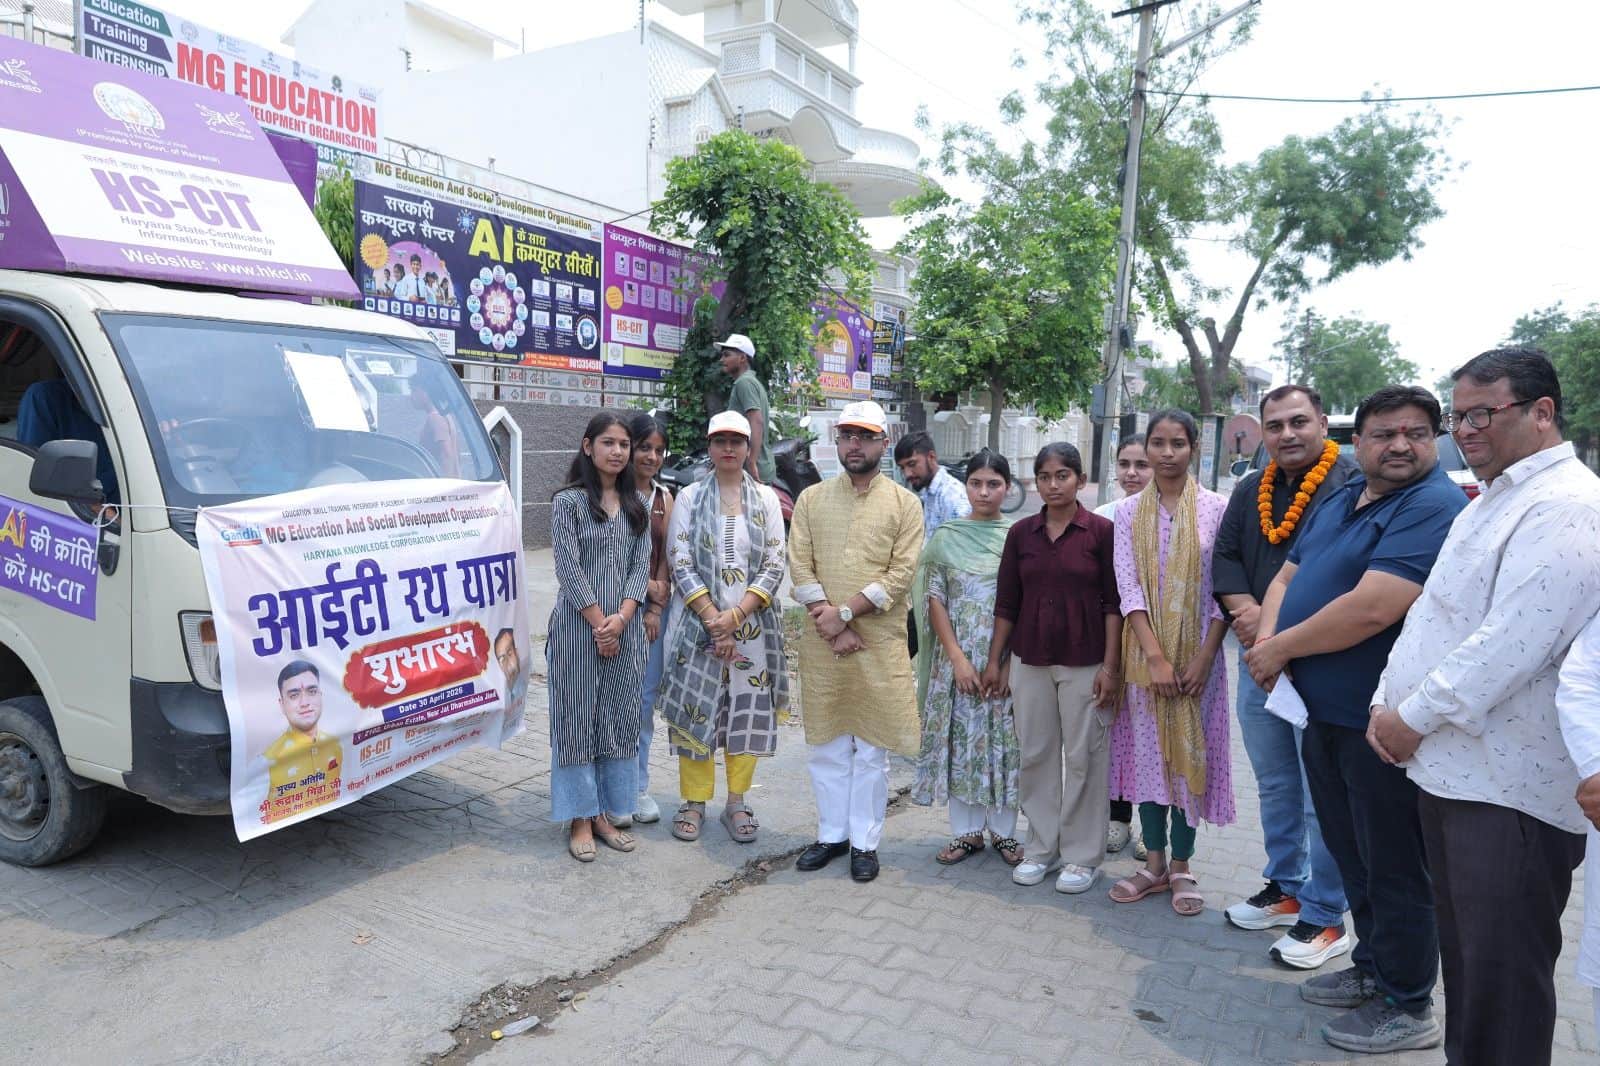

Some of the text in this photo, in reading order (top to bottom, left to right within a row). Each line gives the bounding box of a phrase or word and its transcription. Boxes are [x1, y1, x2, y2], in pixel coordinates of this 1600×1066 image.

[91, 16, 148, 51] Training
[92, 44, 165, 77] INTERNSHIP
[177, 42, 377, 138] MG EDUCATION
[248, 104, 306, 134] VELOPMENT
[309, 123, 377, 154] ORGANISATION
[90, 168, 263, 233] HS-CIT
[375, 161, 392, 177] MG
[395, 167, 445, 191] Education
[447, 182, 465, 196] And
[467, 187, 494, 202] Social
[496, 196, 546, 217] Development
[548, 210, 592, 230] Organisation
[383, 195, 434, 220] सरकारी
[120, 215, 172, 231] Haryana
[360, 209, 416, 238] कम्प्यूटर
[420, 219, 455, 243] सैन्टर
[469, 217, 514, 264] AI
[138, 229, 273, 257] Information Technology
[121, 247, 312, 283] Website: www.hkcl.in
[616, 319, 643, 334] HS-CIT
[265, 526, 287, 544] MG
[288, 520, 344, 542] Education
[345, 516, 366, 536] And
[367, 513, 398, 532] Social
[398, 508, 451, 528] Development
[450, 504, 498, 524] Organisation
[282, 507, 311, 519] EDUCATION
[29, 525, 51, 556] की
[304, 548, 341, 561] HARYANA
[343, 540, 389, 557] KNOWLEDGE
[390, 534, 435, 548] CORPORATION
[436, 531, 461, 543] LIMITED
[3, 553, 86, 605] करें HS-CIT
[247, 551, 517, 657] आईटी रथ यात्रा
[363, 627, 478, 695] शुभारंभ
[398, 702, 417, 713] Date
[418, 698, 428, 708] 30
[429, 692, 445, 705] April
[359, 736, 393, 762] HS-CIT
[259, 799, 271, 813] श्री
[329, 777, 341, 789] जी
